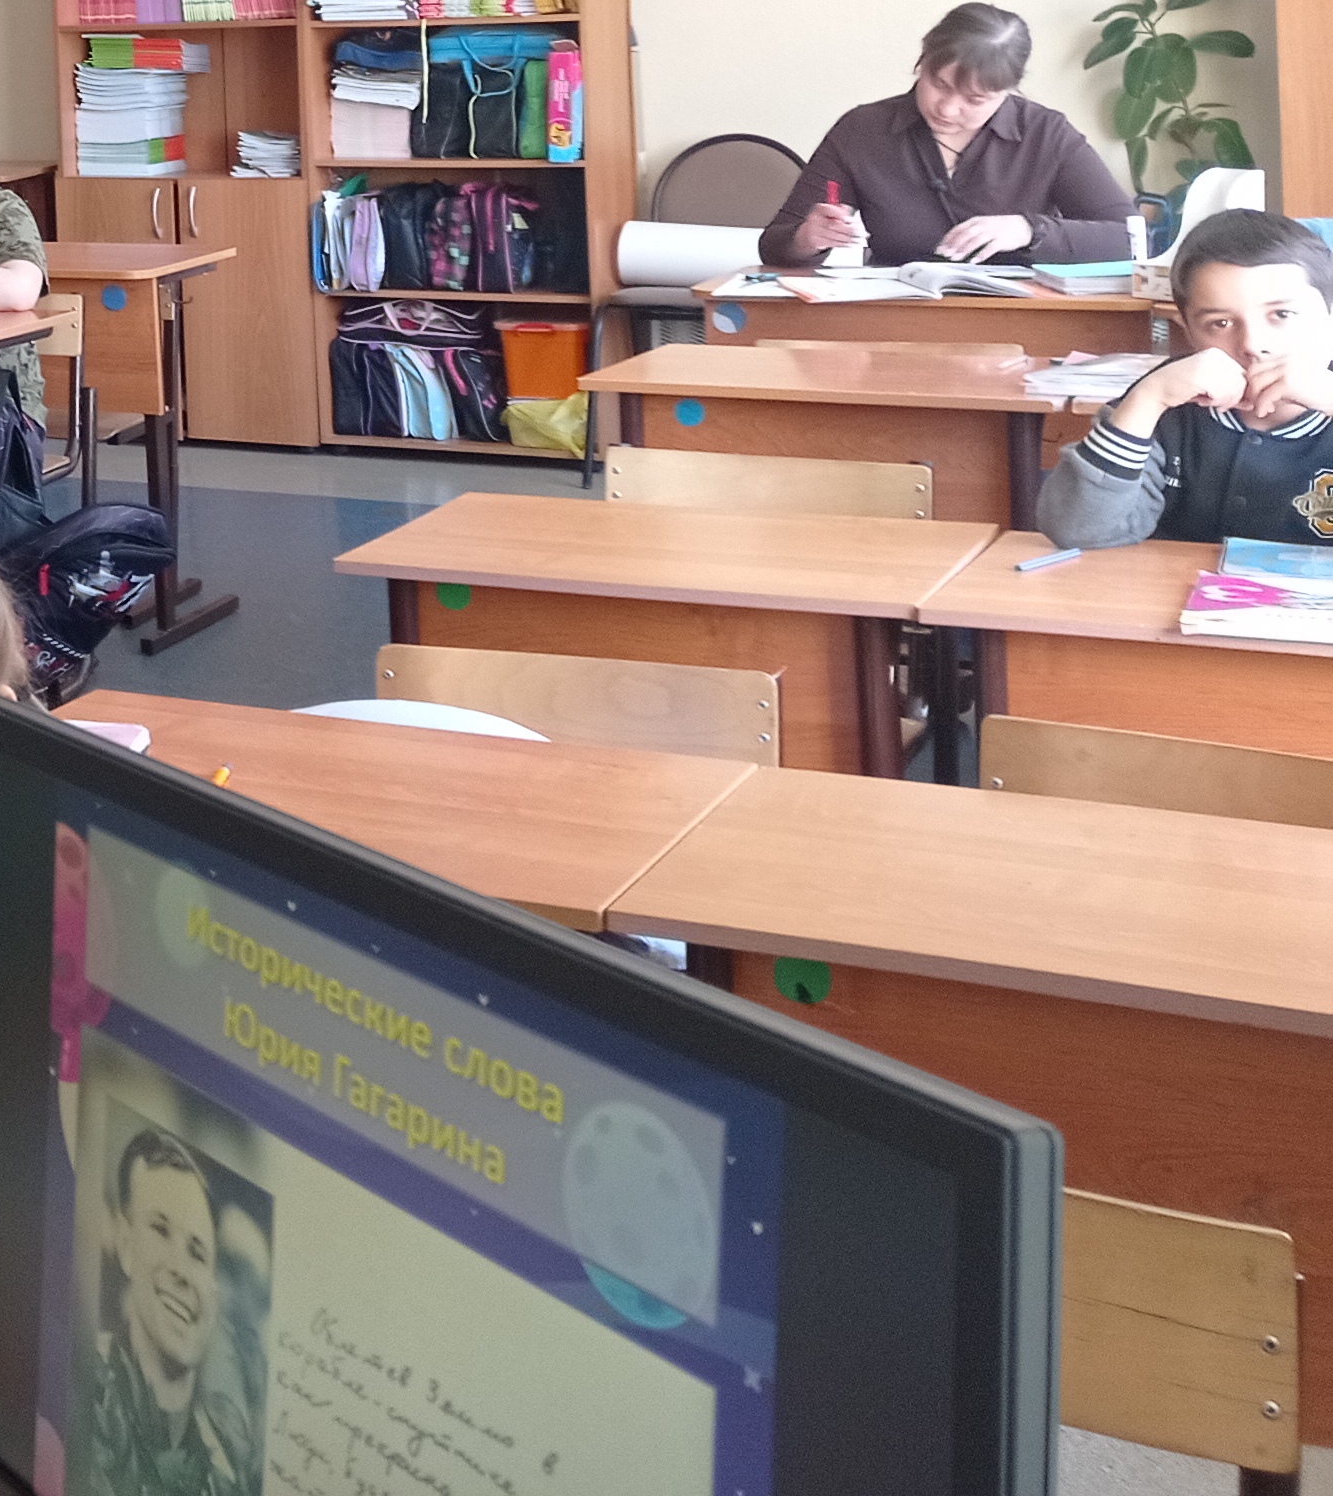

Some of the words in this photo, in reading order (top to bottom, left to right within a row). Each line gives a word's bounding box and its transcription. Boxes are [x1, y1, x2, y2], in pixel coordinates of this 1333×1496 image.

[187, 906, 433, 1059] Исторические
[444, 1036, 565, 1124] слова
[224, 996, 322, 1086] Юрия
[335, 1052, 506, 1185] Гагарина
